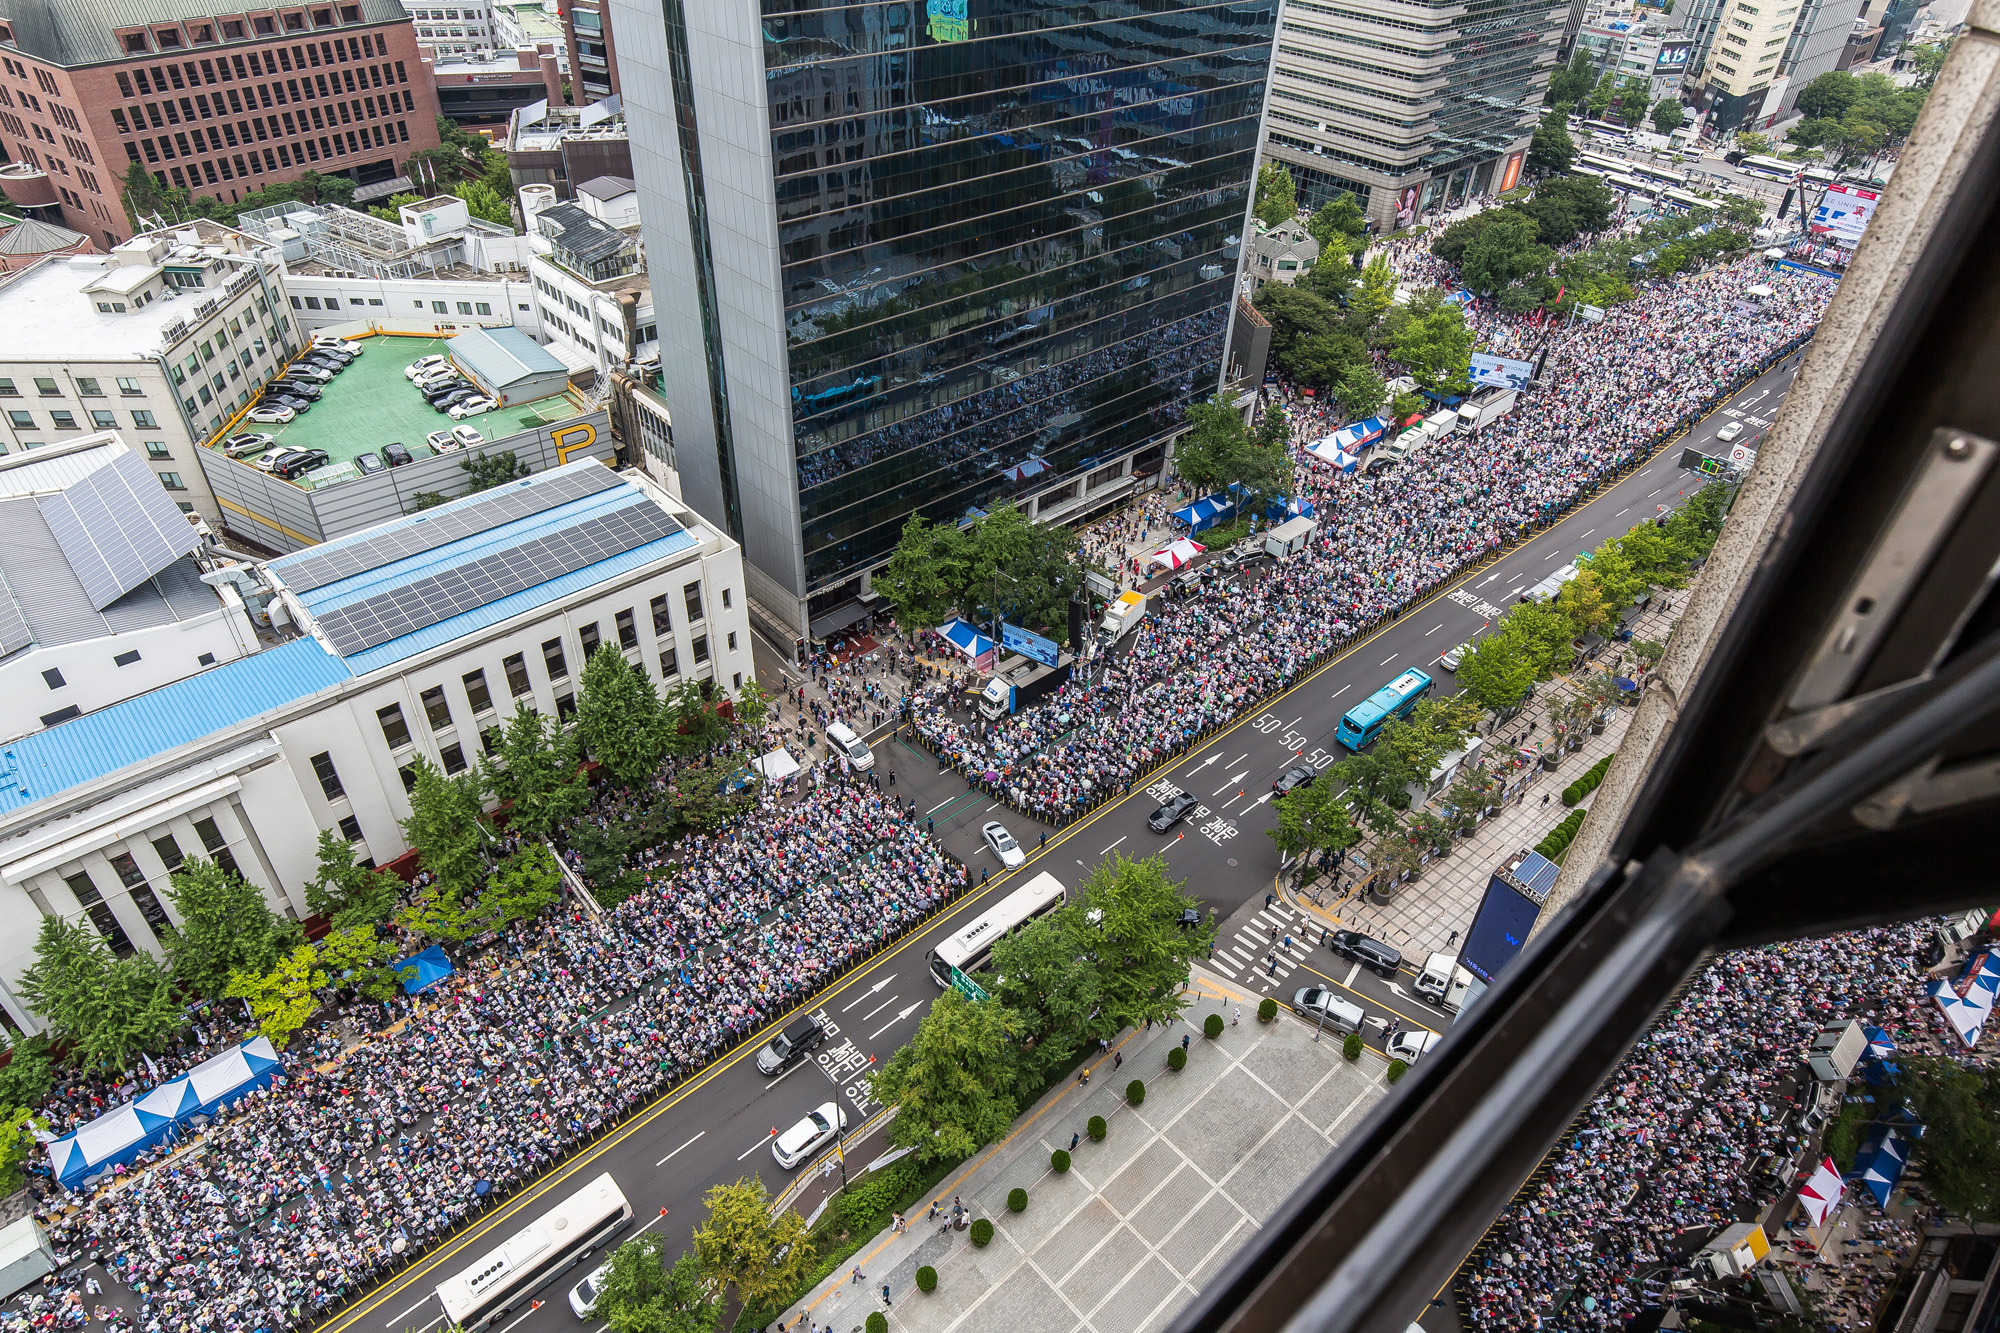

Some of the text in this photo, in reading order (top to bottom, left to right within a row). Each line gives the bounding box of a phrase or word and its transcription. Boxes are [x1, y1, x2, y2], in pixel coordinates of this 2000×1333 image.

[550, 423, 597, 465] P
[1252, 713, 1282, 734] 50
[1278, 731, 1307, 752] 50
[1305, 747, 1334, 770] 50
[1199, 816, 1240, 847] 광화문
[818, 1037, 867, 1082] 광화문
